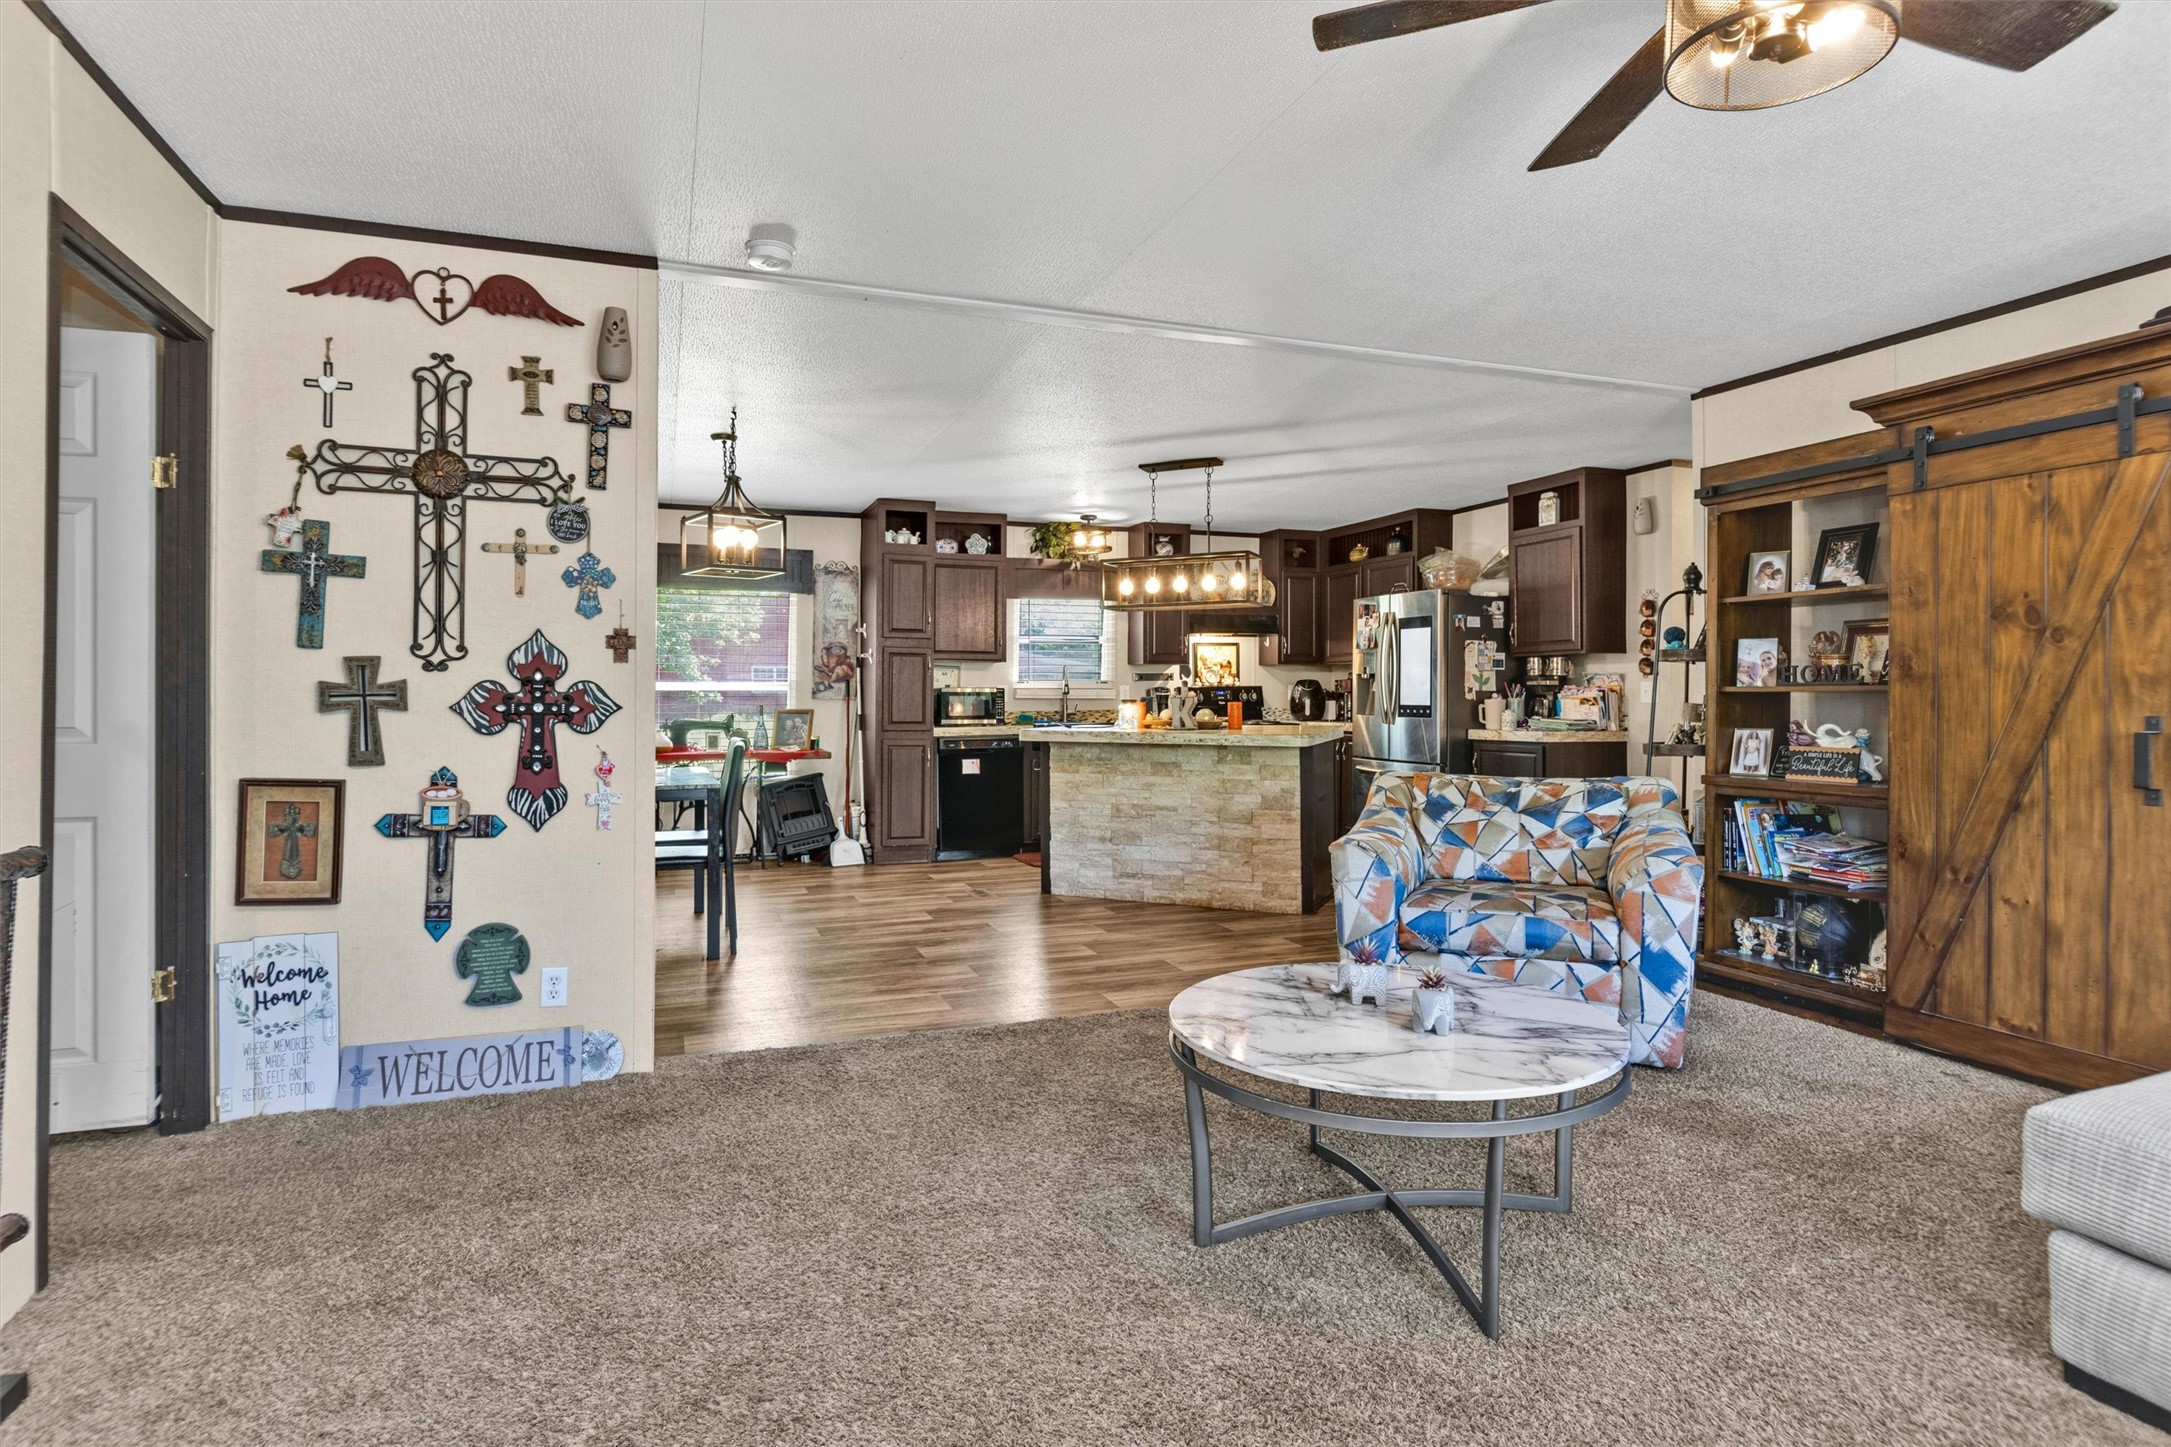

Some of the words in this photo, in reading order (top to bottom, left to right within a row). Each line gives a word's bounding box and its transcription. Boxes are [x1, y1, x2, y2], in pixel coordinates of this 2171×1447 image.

[555, 519, 571, 527] LOVE
[1780, 663, 1865, 684] HOME
[1791, 754, 1835, 777] Beautiful
[1834, 757, 1855, 778] Life
[241, 961, 329, 989] Welcome
[254, 989, 312, 1011] Home
[242, 1040, 270, 1057] WHERE
[273, 1035, 315, 1053] MEMORIES
[246, 1056, 261, 1072] ARE
[292, 1051, 312, 1066] LOVE
[377, 1039, 556, 1099] WELCOME
[254, 1071, 263, 1086] IS
[266, 1068, 285, 1084] FELT
[288, 1067, 305, 1082] AND
[242, 1085, 274, 1103] REFUGE
[277, 1084, 287, 1099] IS
[289, 1080, 316, 1097] FOUND
